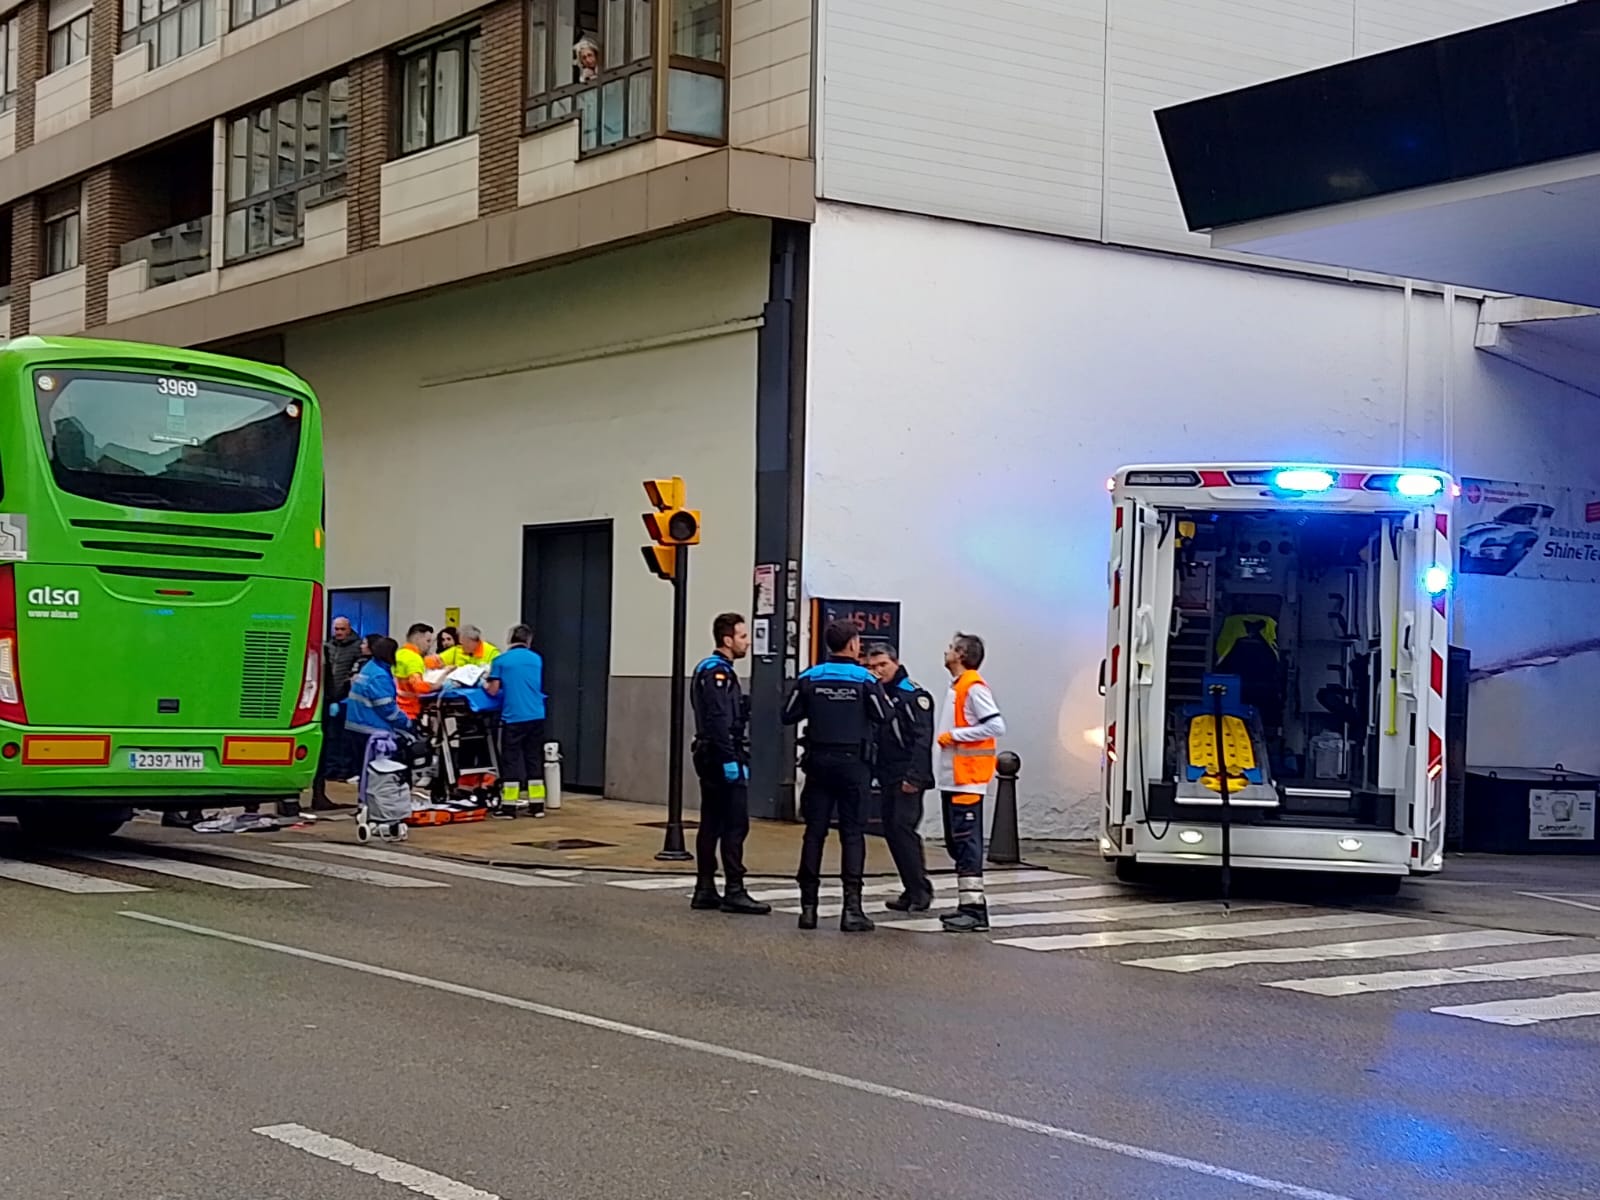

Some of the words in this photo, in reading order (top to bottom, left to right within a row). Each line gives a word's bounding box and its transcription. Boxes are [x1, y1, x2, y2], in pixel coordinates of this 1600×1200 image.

[157, 377, 198, 397] 3969
[28, 586, 80, 606] alsa
[138, 754, 171, 768] 2397
[175, 754, 201, 768] HYH
